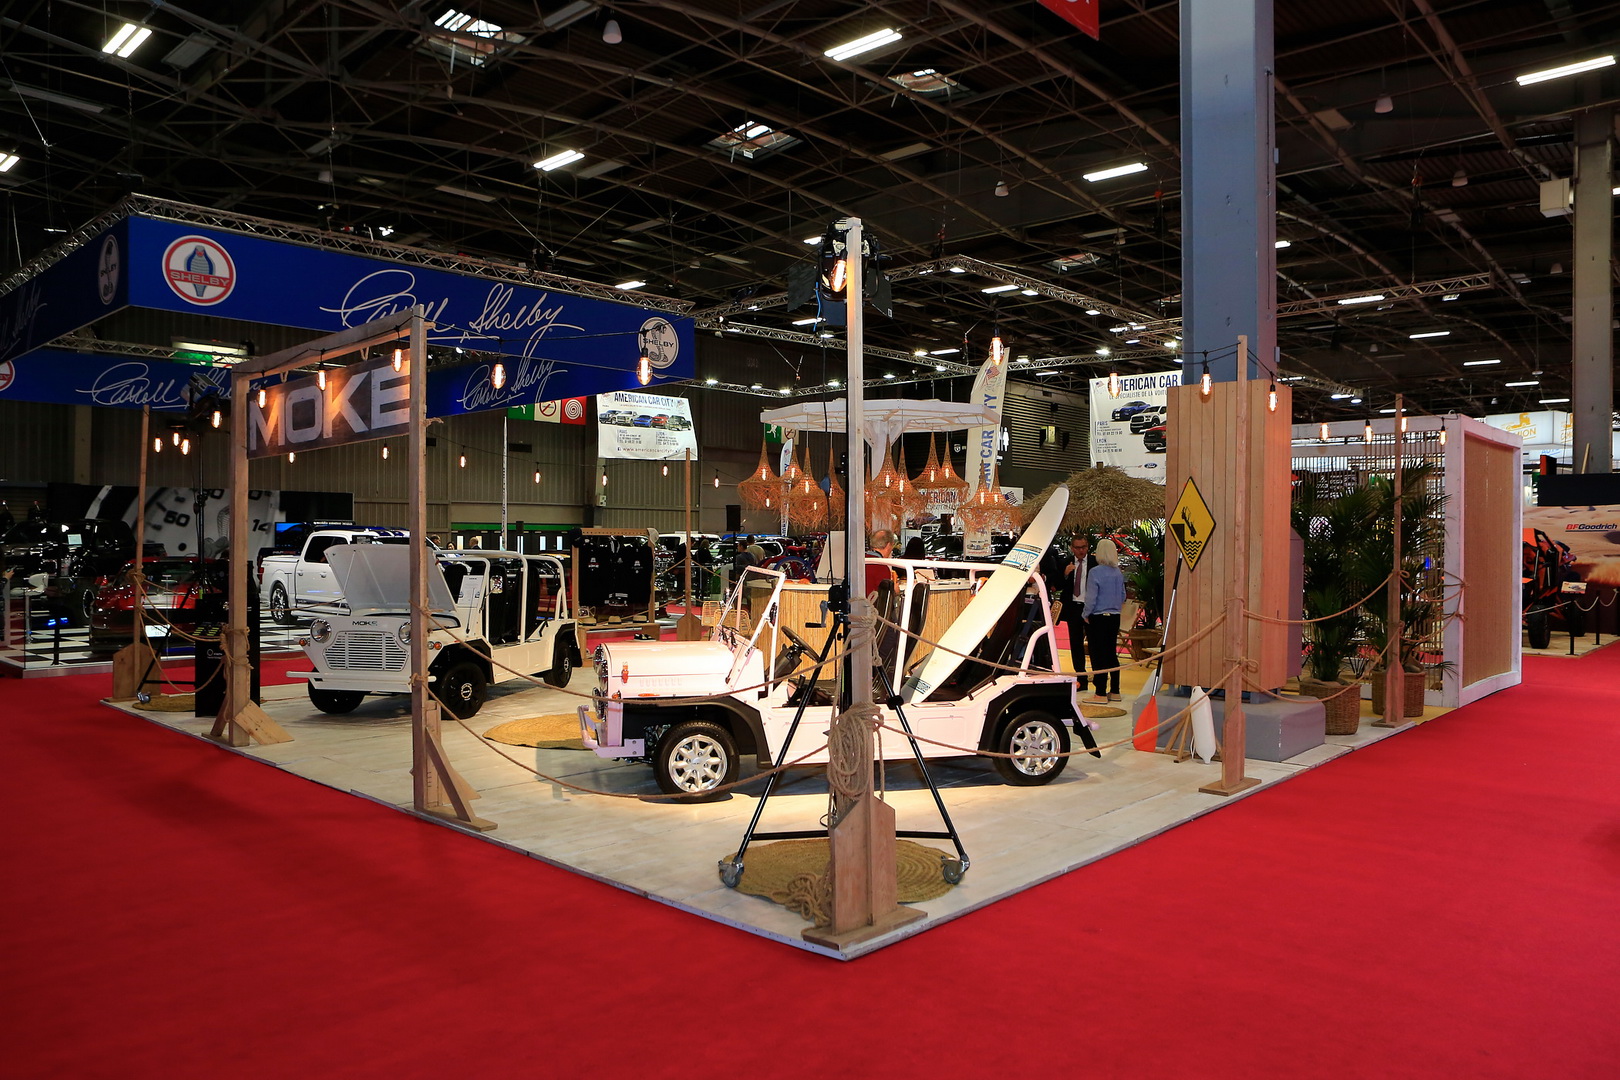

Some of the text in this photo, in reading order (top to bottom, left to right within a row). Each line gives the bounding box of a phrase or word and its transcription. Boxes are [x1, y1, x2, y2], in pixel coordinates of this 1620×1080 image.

[169, 271, 230, 287] SHELBY
[643, 337, 674, 348] SHELBY
[1159, 374, 1179, 388] CAR
[249, 360, 410, 451] MOKE
[614, 392, 648, 404] AMERICAN
[648, 396, 661, 405] CAR
[980, 429, 994, 459] CAR
